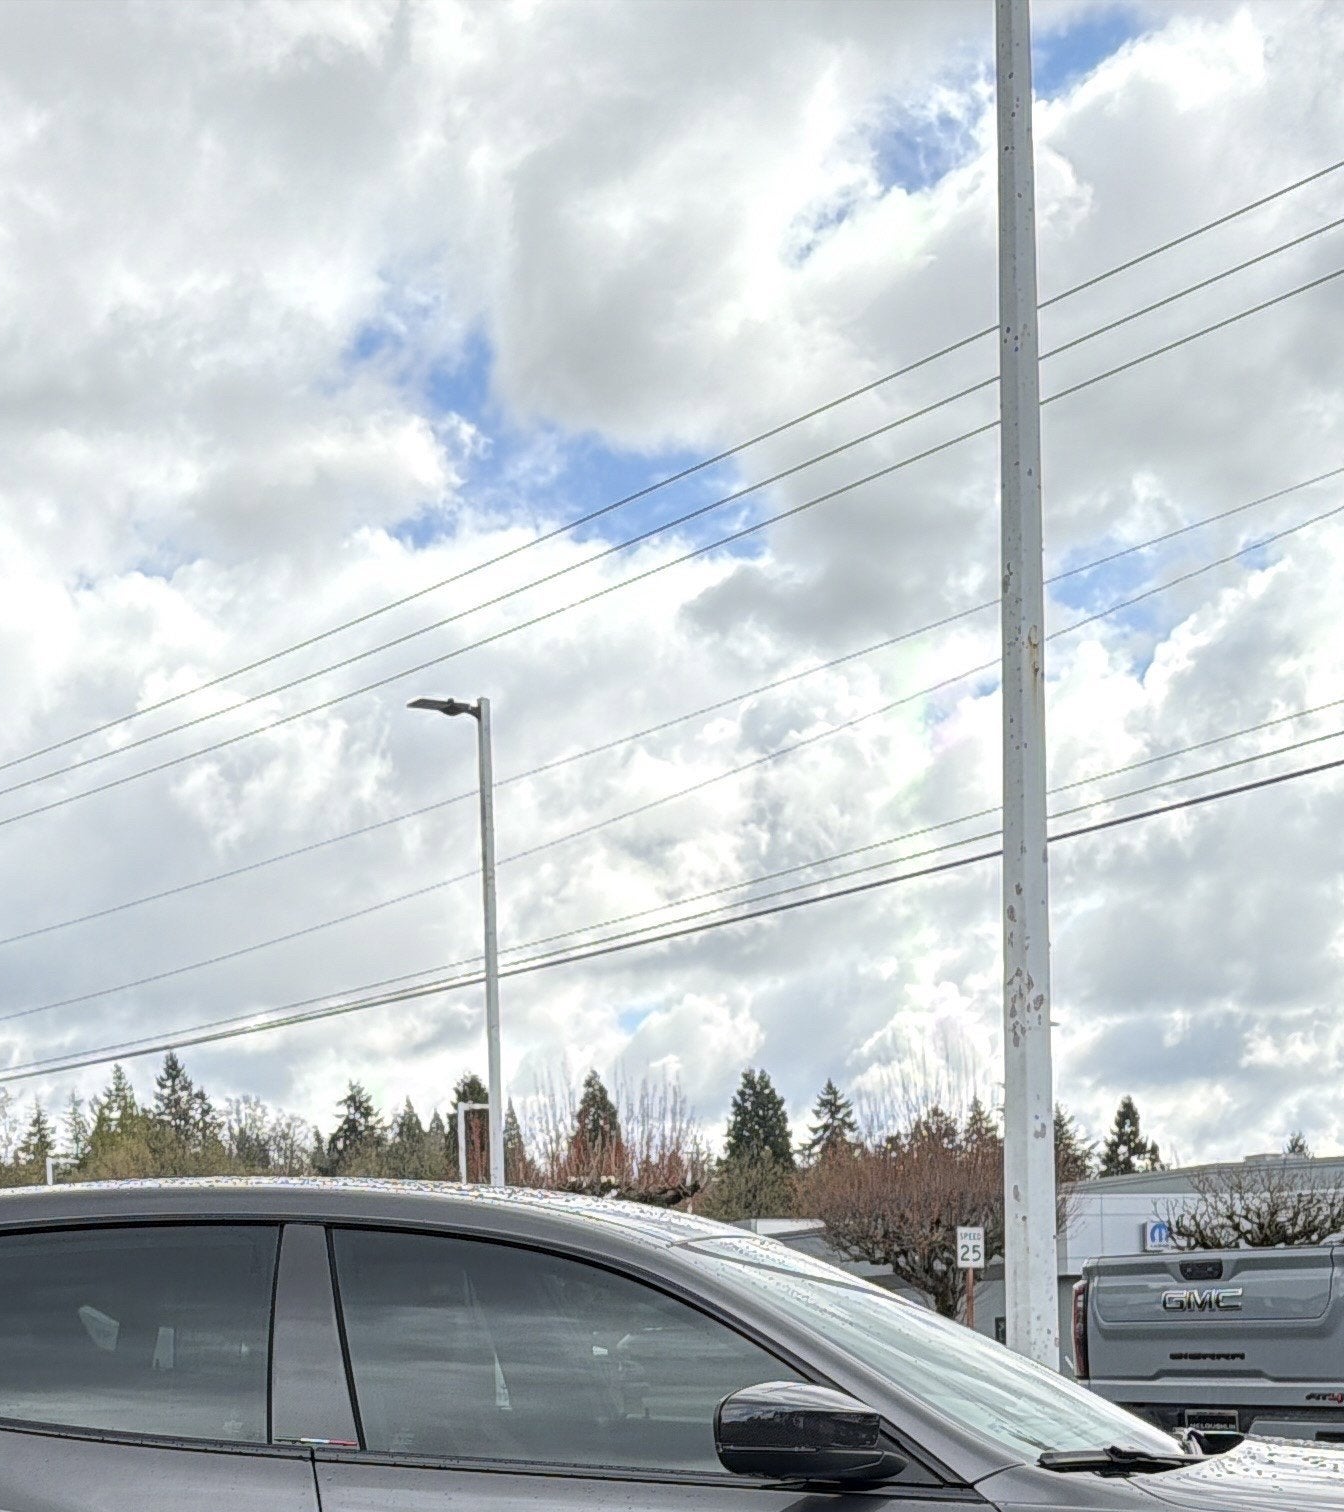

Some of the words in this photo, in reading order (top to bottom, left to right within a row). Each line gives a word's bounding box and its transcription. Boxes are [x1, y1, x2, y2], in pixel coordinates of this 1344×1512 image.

[960, 1232, 981, 1241] SPEED
[960, 1244, 981, 1262] 25
[1161, 1287, 1243, 1312] GMC
